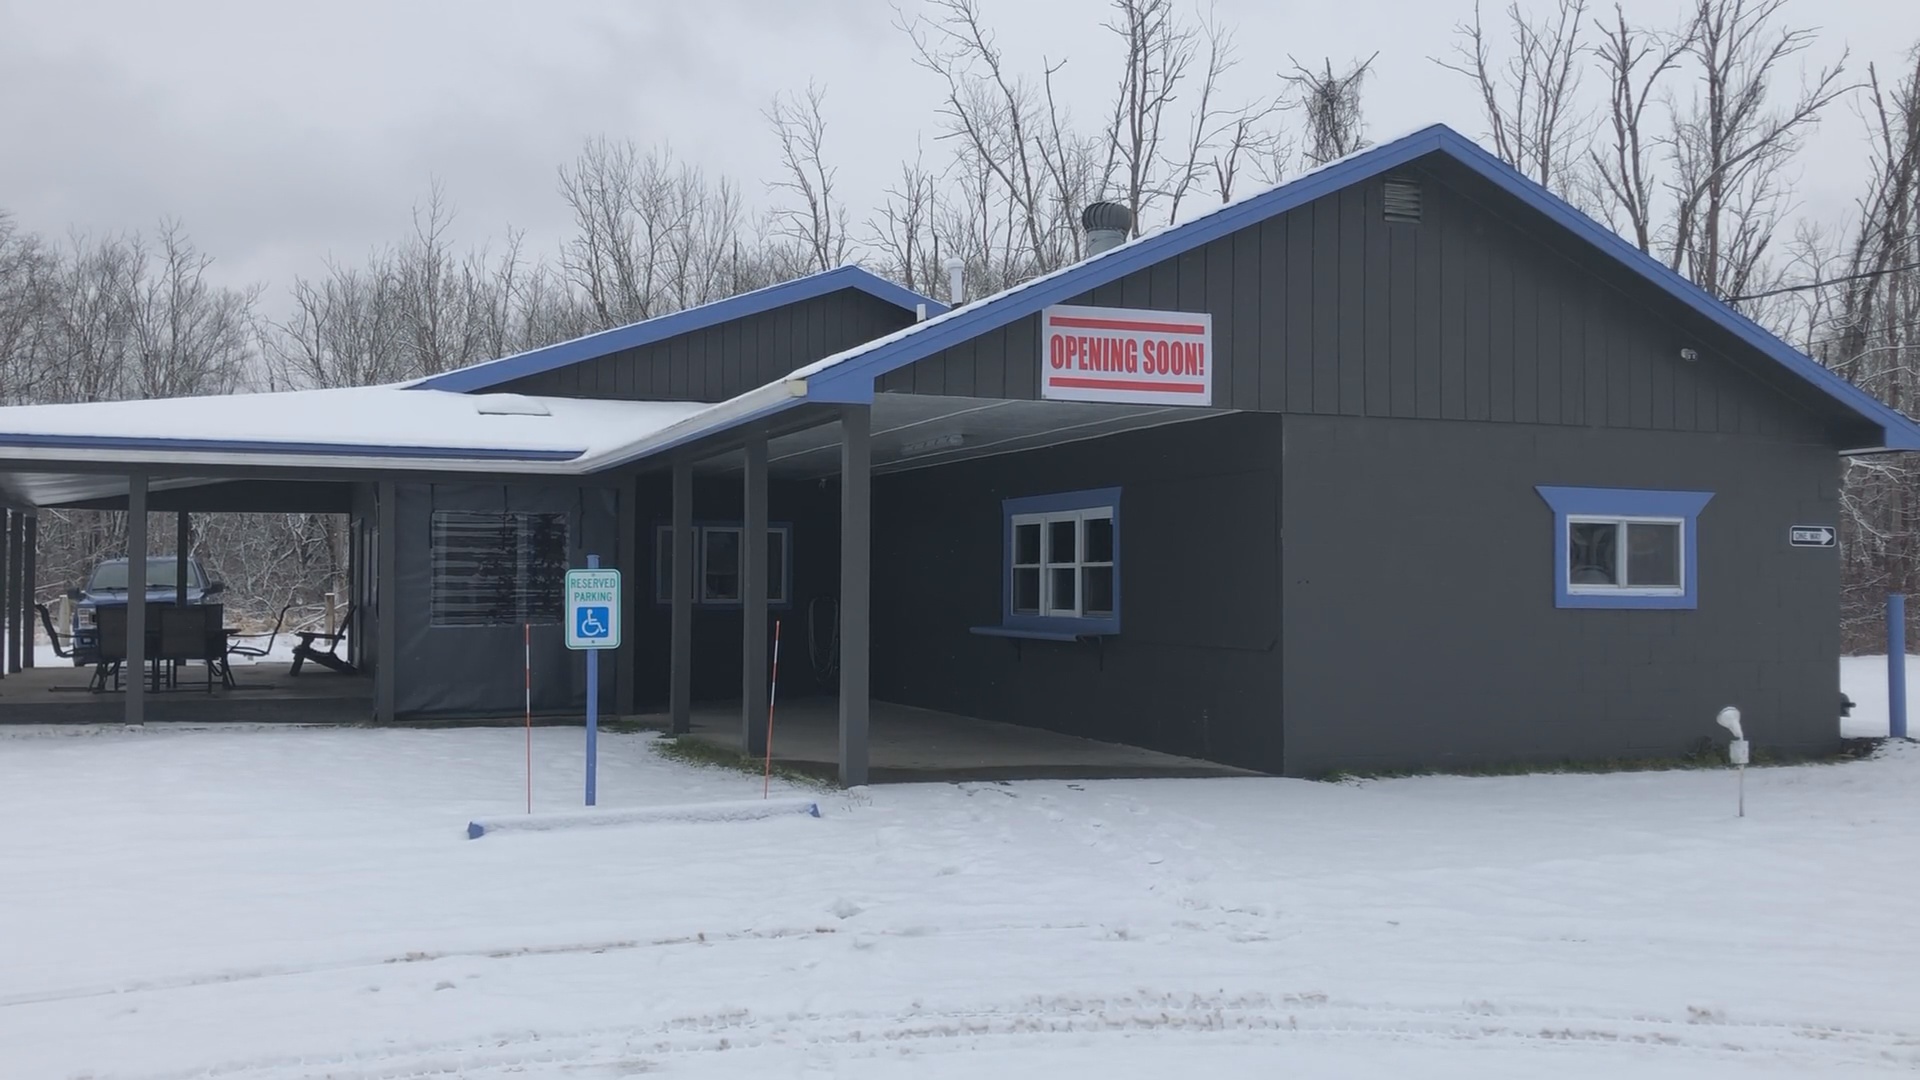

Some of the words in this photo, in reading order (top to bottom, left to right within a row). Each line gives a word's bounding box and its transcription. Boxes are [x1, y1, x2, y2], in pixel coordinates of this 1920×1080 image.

[1050, 334, 1138, 374] OPENING
[1143, 339, 1204, 376] SOON!
[1794, 531, 1809, 540] ONE
[1810, 532, 1821, 540] WAY
[570, 578, 616, 589] RESERVED
[574, 591, 612, 602] PARKING
